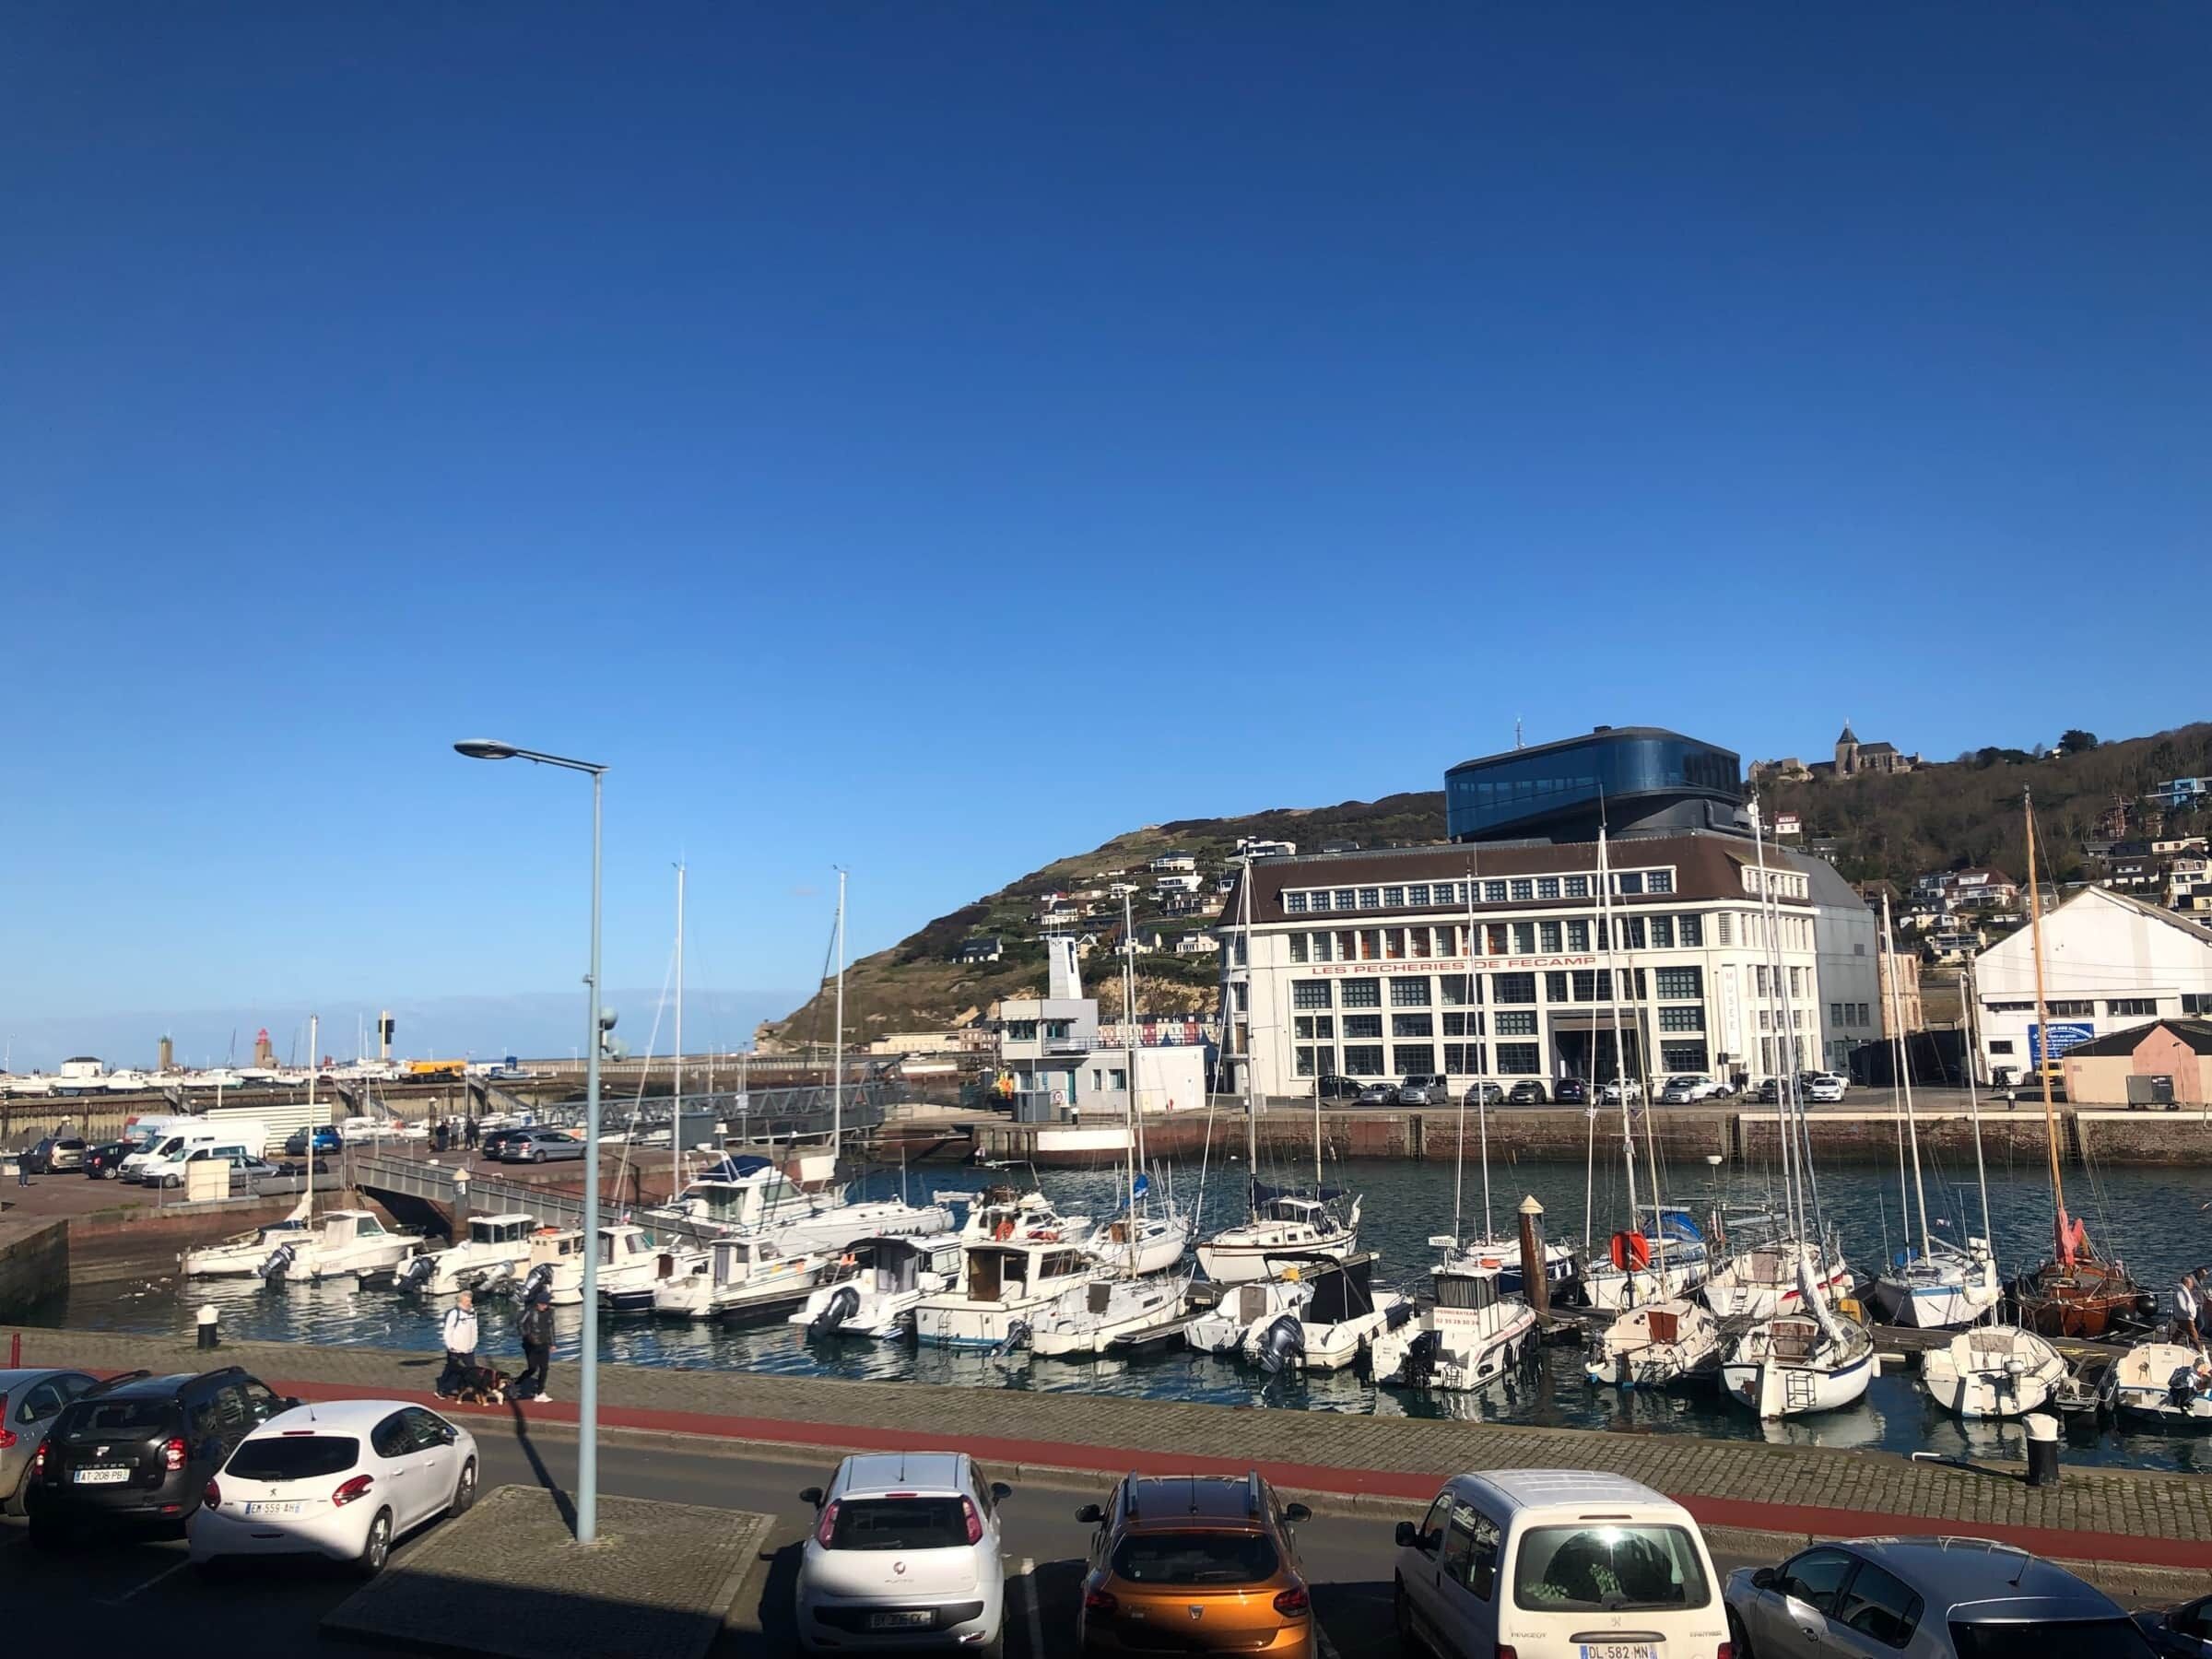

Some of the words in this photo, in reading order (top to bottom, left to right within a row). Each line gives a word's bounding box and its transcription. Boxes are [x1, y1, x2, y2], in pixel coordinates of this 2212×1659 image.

[1312, 966, 1347, 974] LES
[1354, 961, 1465, 974] PECHERIES
[1474, 960, 1500, 970] DE
[1508, 957, 1596, 968] FECAMP
